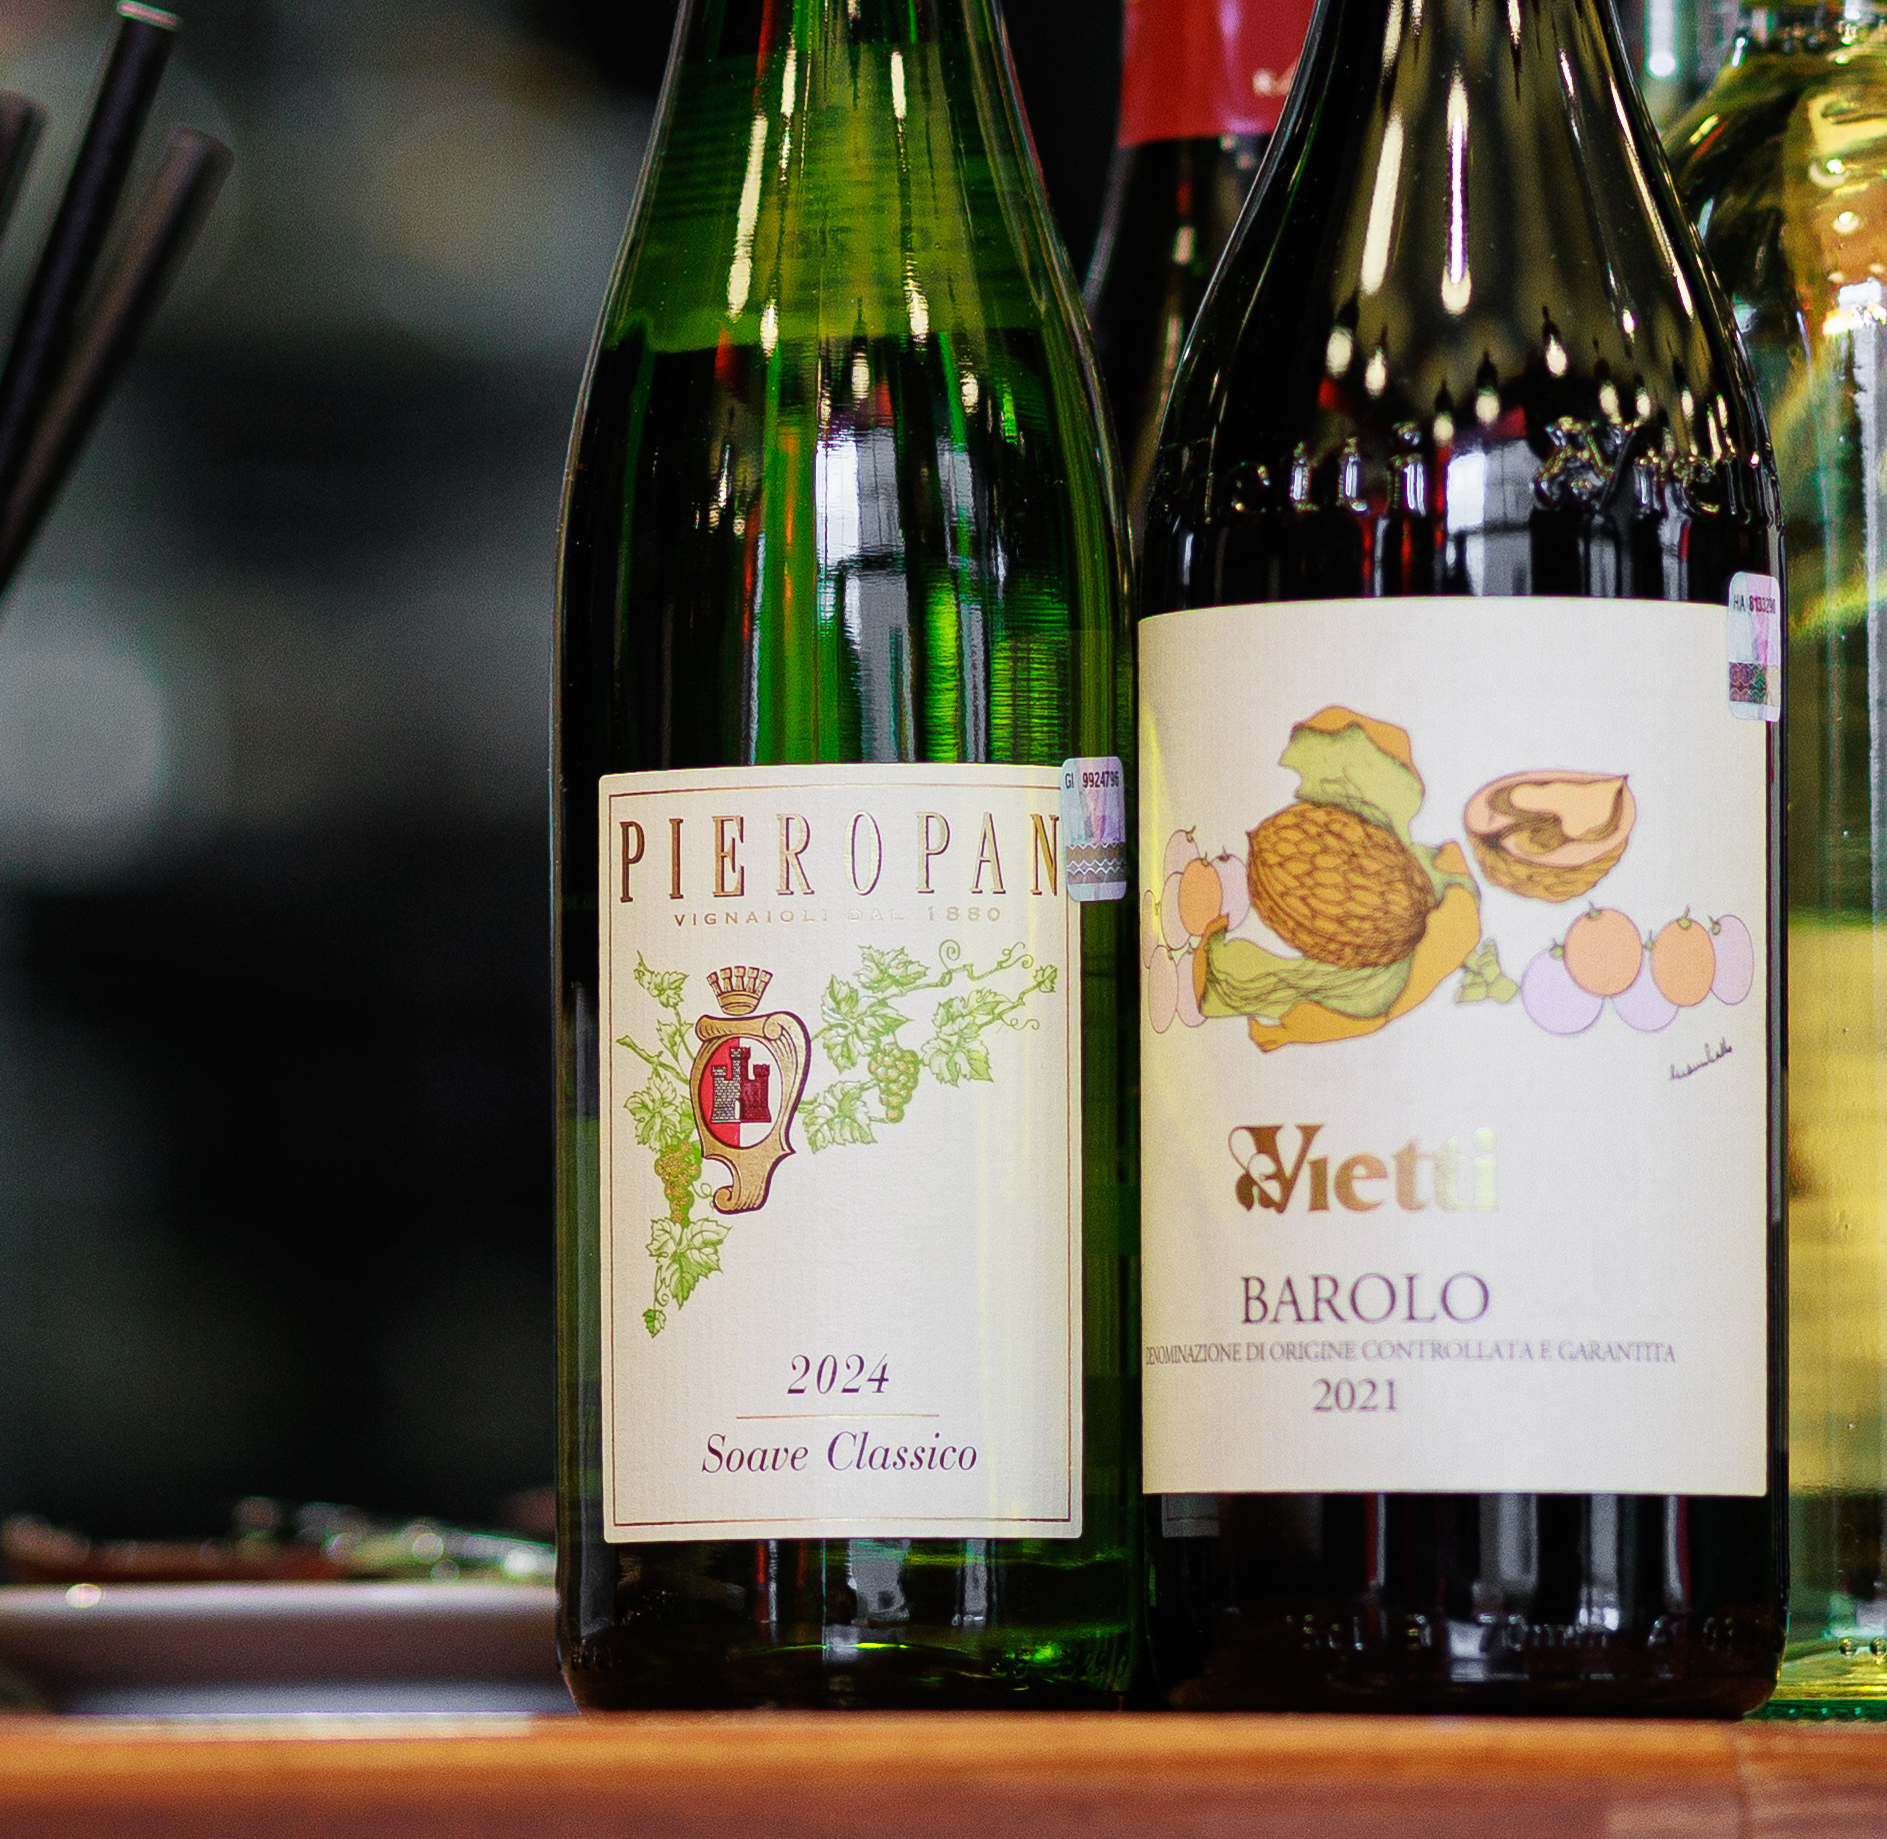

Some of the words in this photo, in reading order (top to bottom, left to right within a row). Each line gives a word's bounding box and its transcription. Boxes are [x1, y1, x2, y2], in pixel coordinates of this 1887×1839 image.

[619, 809, 1060, 903] PIEROPAN
[673, 909, 829, 927] VIGNAIOLI
[848, 908, 905, 922] DAL
[926, 906, 1001, 923] 1880
[1227, 1123, 1500, 1214] Vietti
[1240, 1271, 1490, 1325] BAROLO
[1245, 1340, 1265, 1361] DI
[1269, 1339, 1357, 1361] ORIGINE
[1361, 1338, 1535, 1361] CONTROLLATA
[1539, 1339, 1553, 1361] E
[1557, 1339, 1676, 1363] GARANTITA
[786, 1352, 890, 1395] 2024
[1312, 1376, 1399, 1413] 2021
[700, 1432, 810, 1474] Soave
[827, 1430, 978, 1472] Classico
